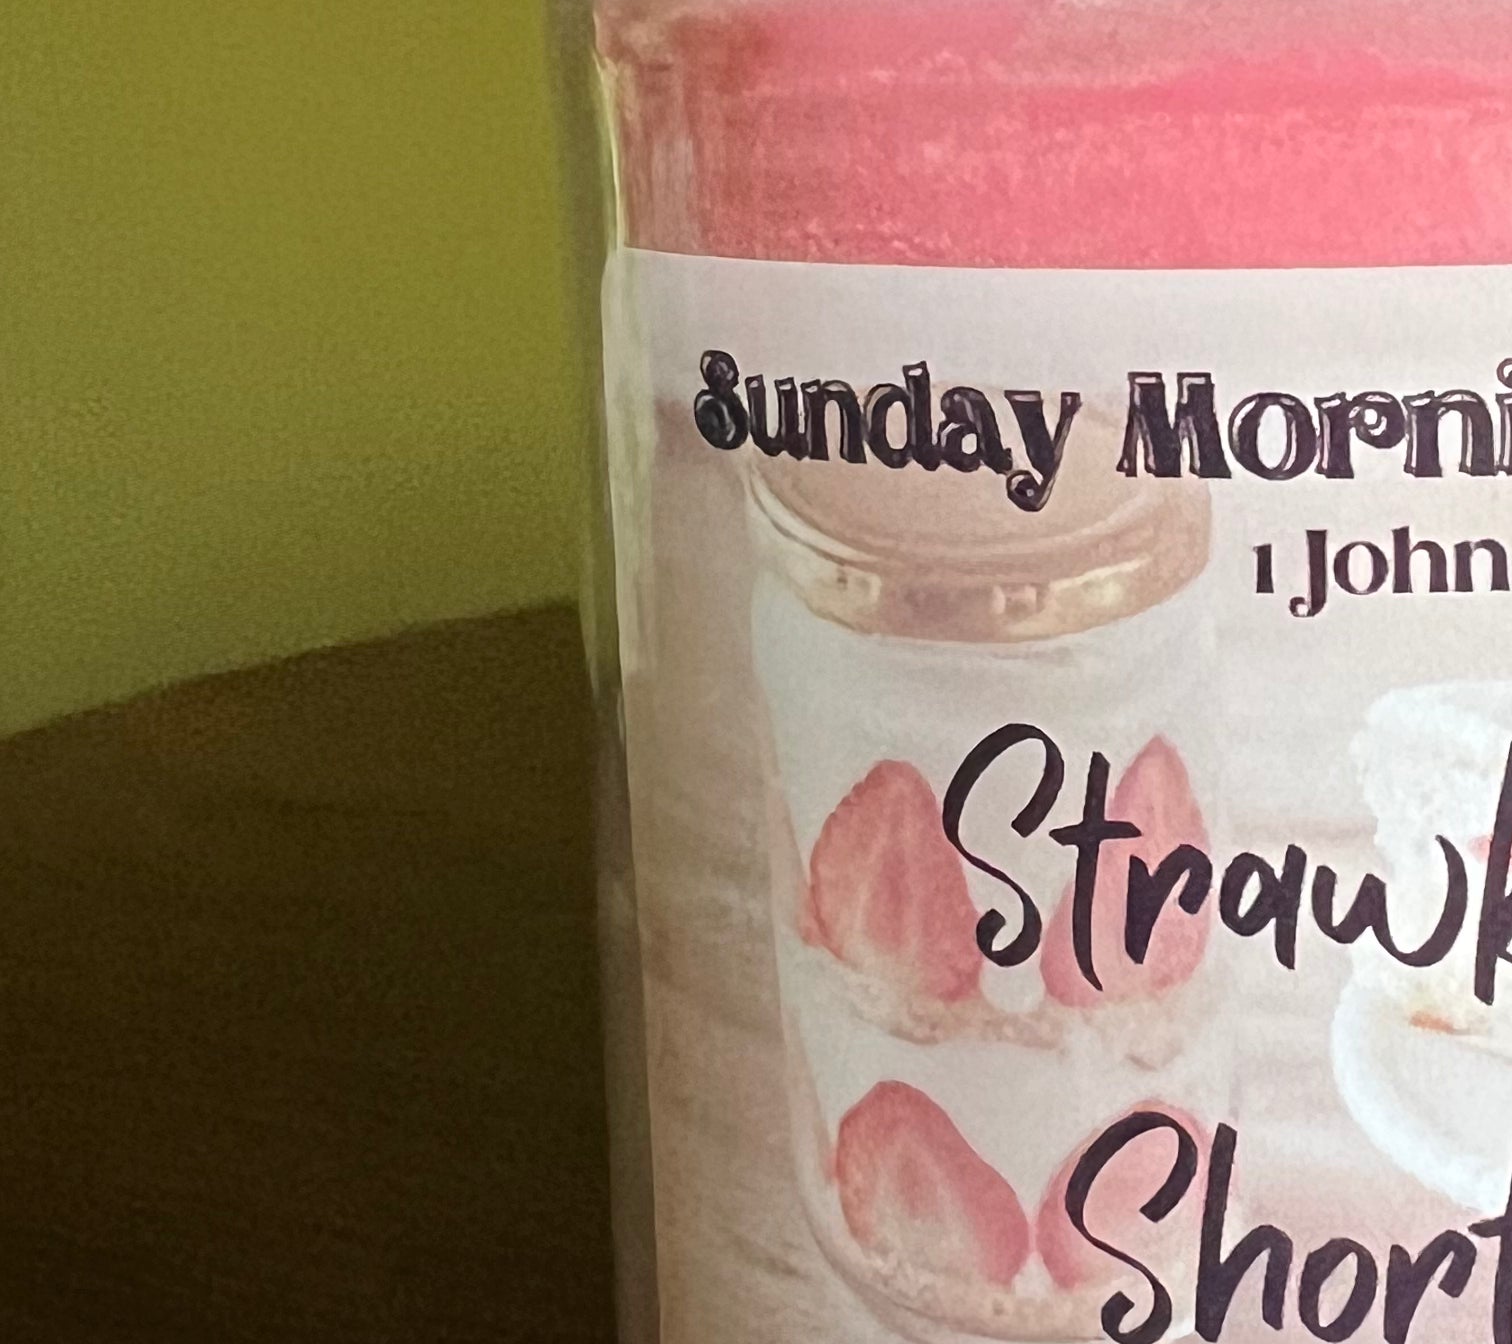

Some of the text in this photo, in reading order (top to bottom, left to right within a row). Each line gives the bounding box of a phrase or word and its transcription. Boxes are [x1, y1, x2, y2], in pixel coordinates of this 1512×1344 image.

[694, 350, 1082, 511] Sunday
[1254, 544, 1274, 594] 1
[1288, 526, 1510, 618] John
